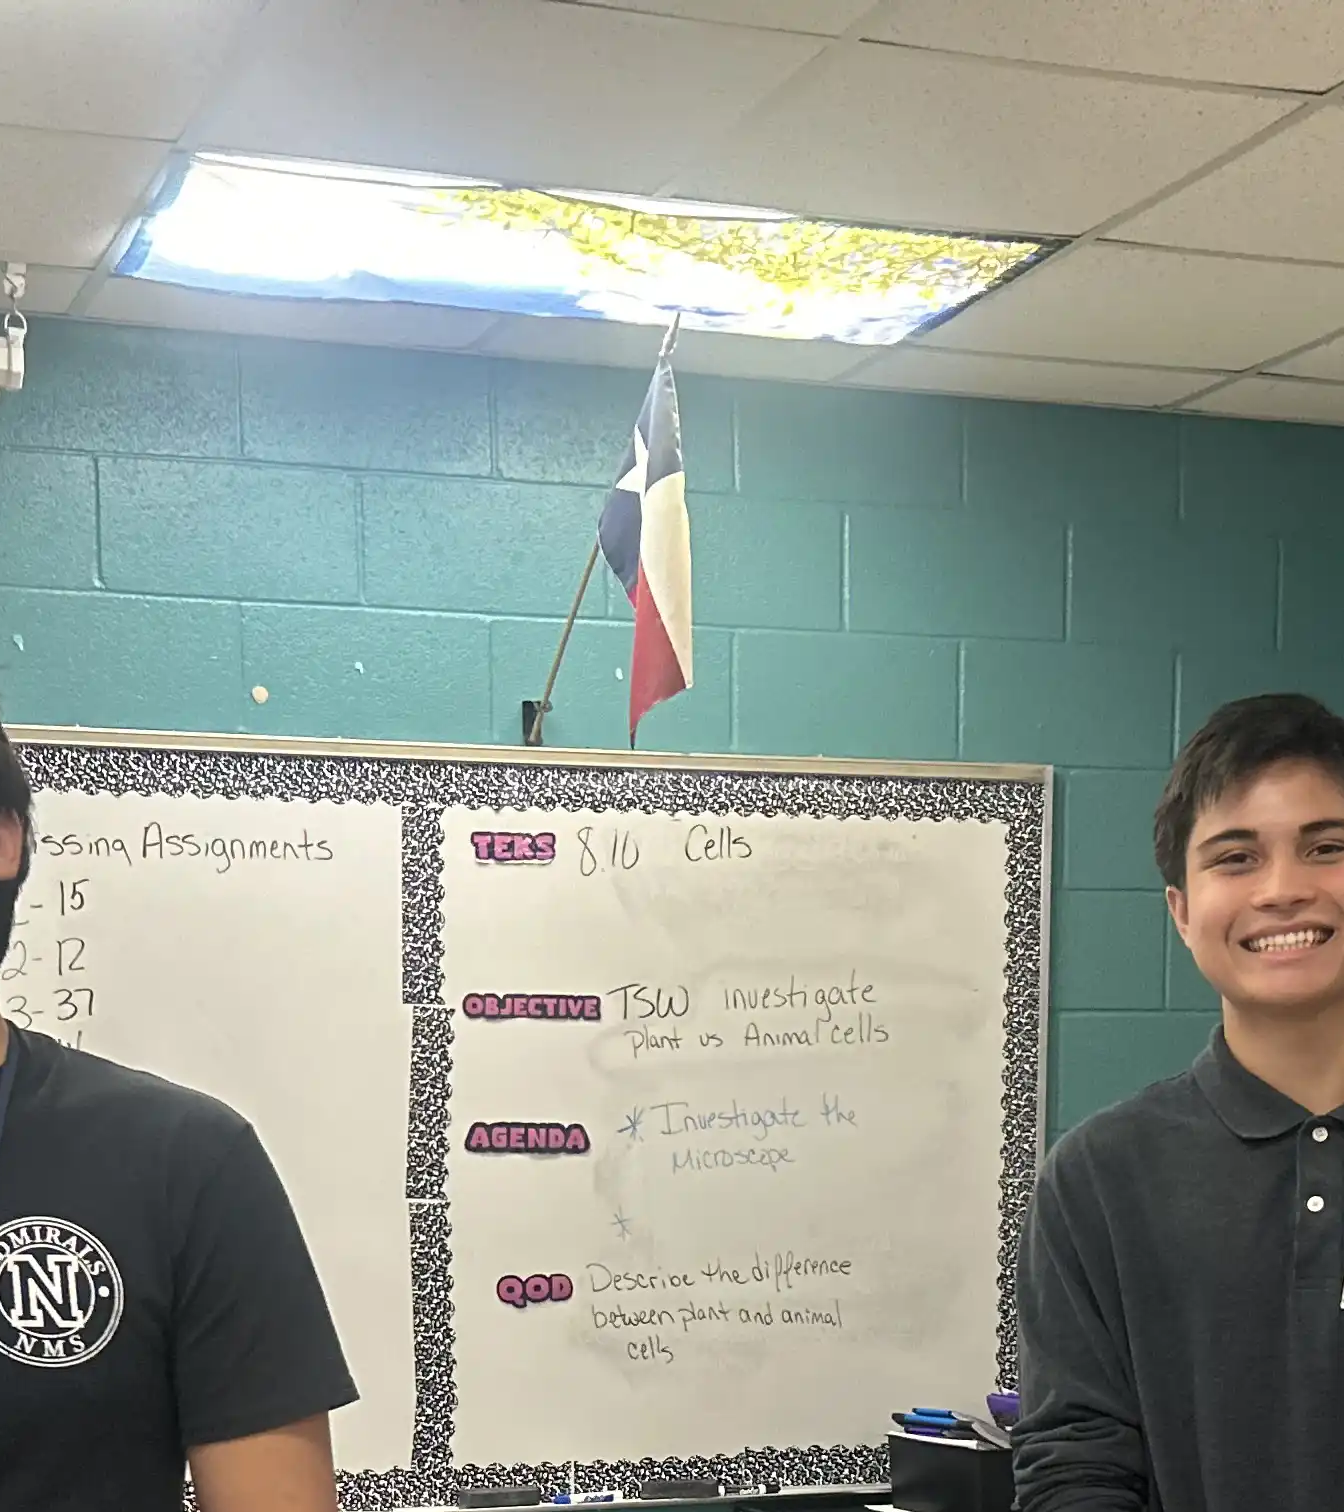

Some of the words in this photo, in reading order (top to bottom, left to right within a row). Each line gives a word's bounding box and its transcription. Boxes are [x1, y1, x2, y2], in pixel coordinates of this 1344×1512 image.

[33, 834, 132, 867] issing
[142, 822, 333, 873] Assignments
[471, 832, 556, 861] TEKS
[685, 824, 753, 862] Cells
[60, 879, 90, 916] 15
[56, 937, 86, 976] 12
[53, 988, 95, 1021] 37
[463, 993, 601, 1020] OBJECTIVE
[606, 984, 690, 1020] TSW
[724, 974, 878, 1022] investigate
[650, 1099, 807, 1140] Investigate
[821, 1093, 858, 1127] the
[465, 1122, 591, 1155] AGENDA
[701, 1259, 749, 1285] the
[751, 1252, 852, 1292] difference
[7, 1254, 85, 1328] N
[497, 1274, 573, 1309] QOD
[592, 1303, 675, 1329] between
[677, 1300, 729, 1332] plant
[739, 1301, 774, 1327] and
[781, 1299, 843, 1328] animal
[14, 1332, 86, 1357] NMS
[627, 1335, 675, 1364] cells
